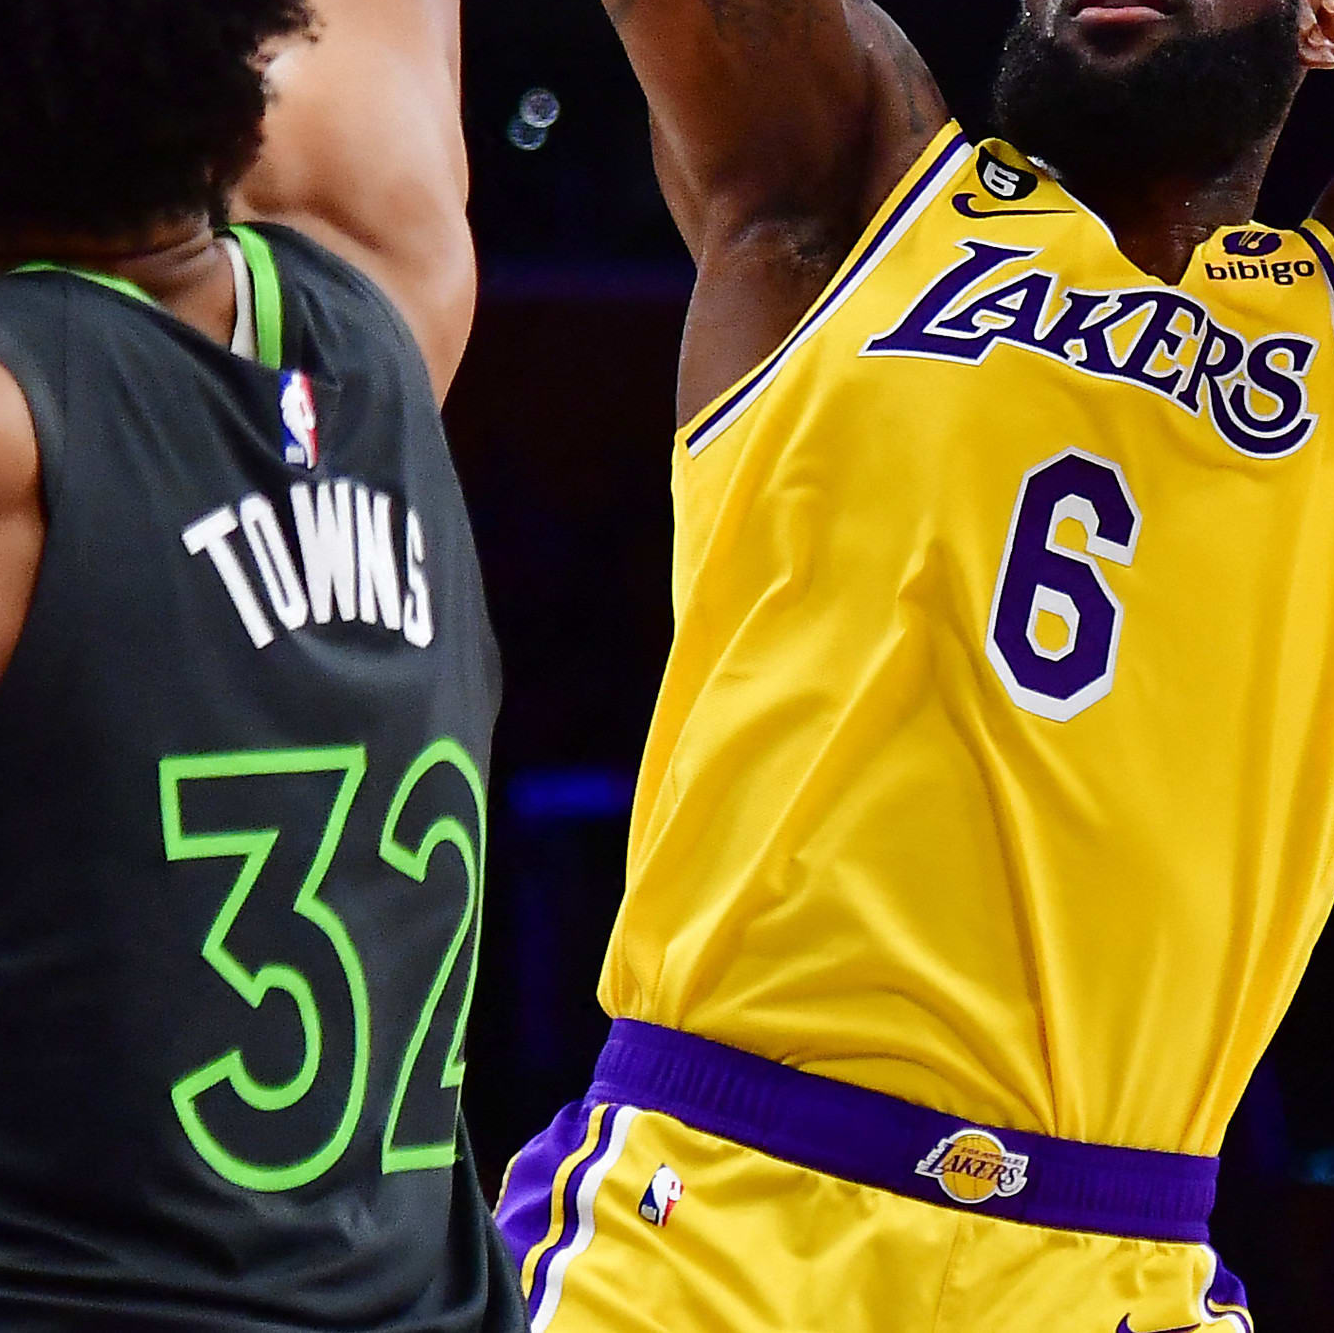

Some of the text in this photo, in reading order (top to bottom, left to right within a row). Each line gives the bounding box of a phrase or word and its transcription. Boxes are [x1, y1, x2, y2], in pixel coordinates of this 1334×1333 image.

[983, 161, 1019, 196] 6
[858, 238, 1319, 460] LAKERS
[1205, 258, 1315, 286] bibigo
[180, 477, 435, 649] TOWNS
[985, 446, 1143, 723] 6
[159, 737, 486, 1192] 32
[917, 1139, 1027, 1196] LAKERS
